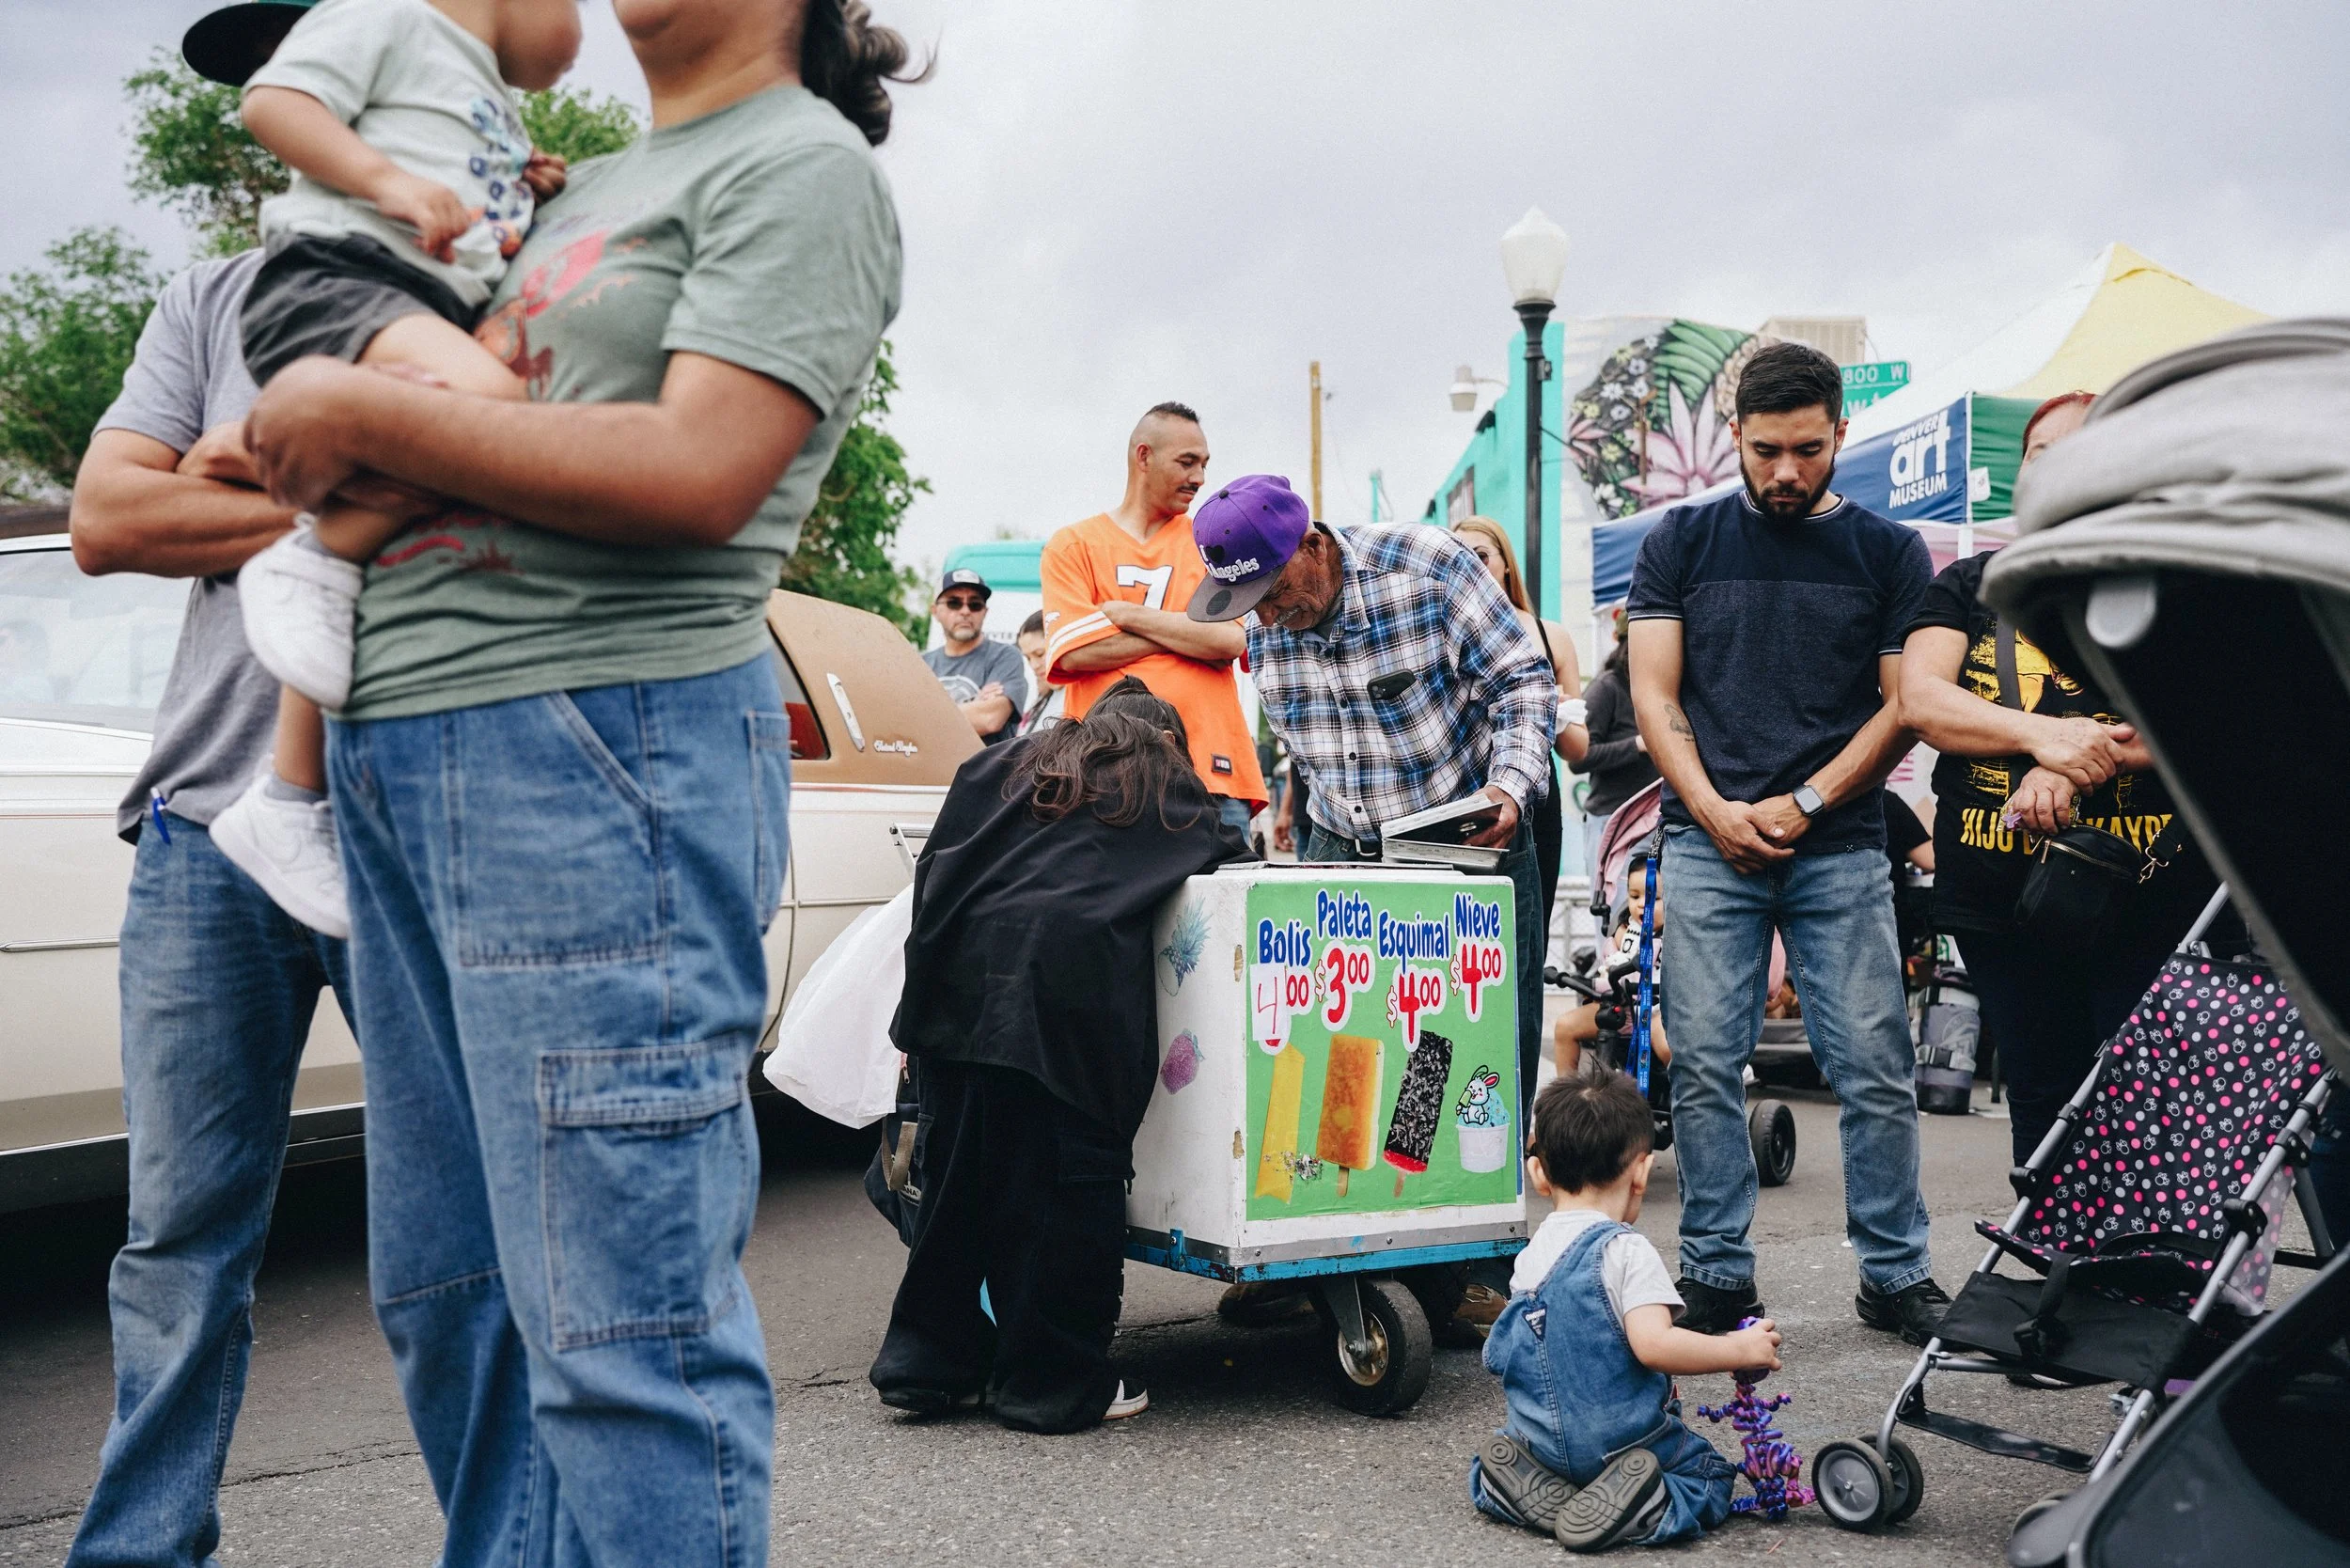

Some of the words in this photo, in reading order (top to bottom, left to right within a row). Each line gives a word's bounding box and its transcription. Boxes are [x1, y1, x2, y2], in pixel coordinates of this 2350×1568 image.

[1890, 364, 1905, 381] W
[1889, 408, 1951, 488] art
[1888, 471, 1949, 510] MUSEUM
[1116, 564, 1174, 610] 7
[1317, 890, 1372, 939] Paleta
[1455, 894, 1500, 939] Nieve
[1259, 919, 1312, 967] Bolis
[1379, 911, 1449, 975] Esquimal
